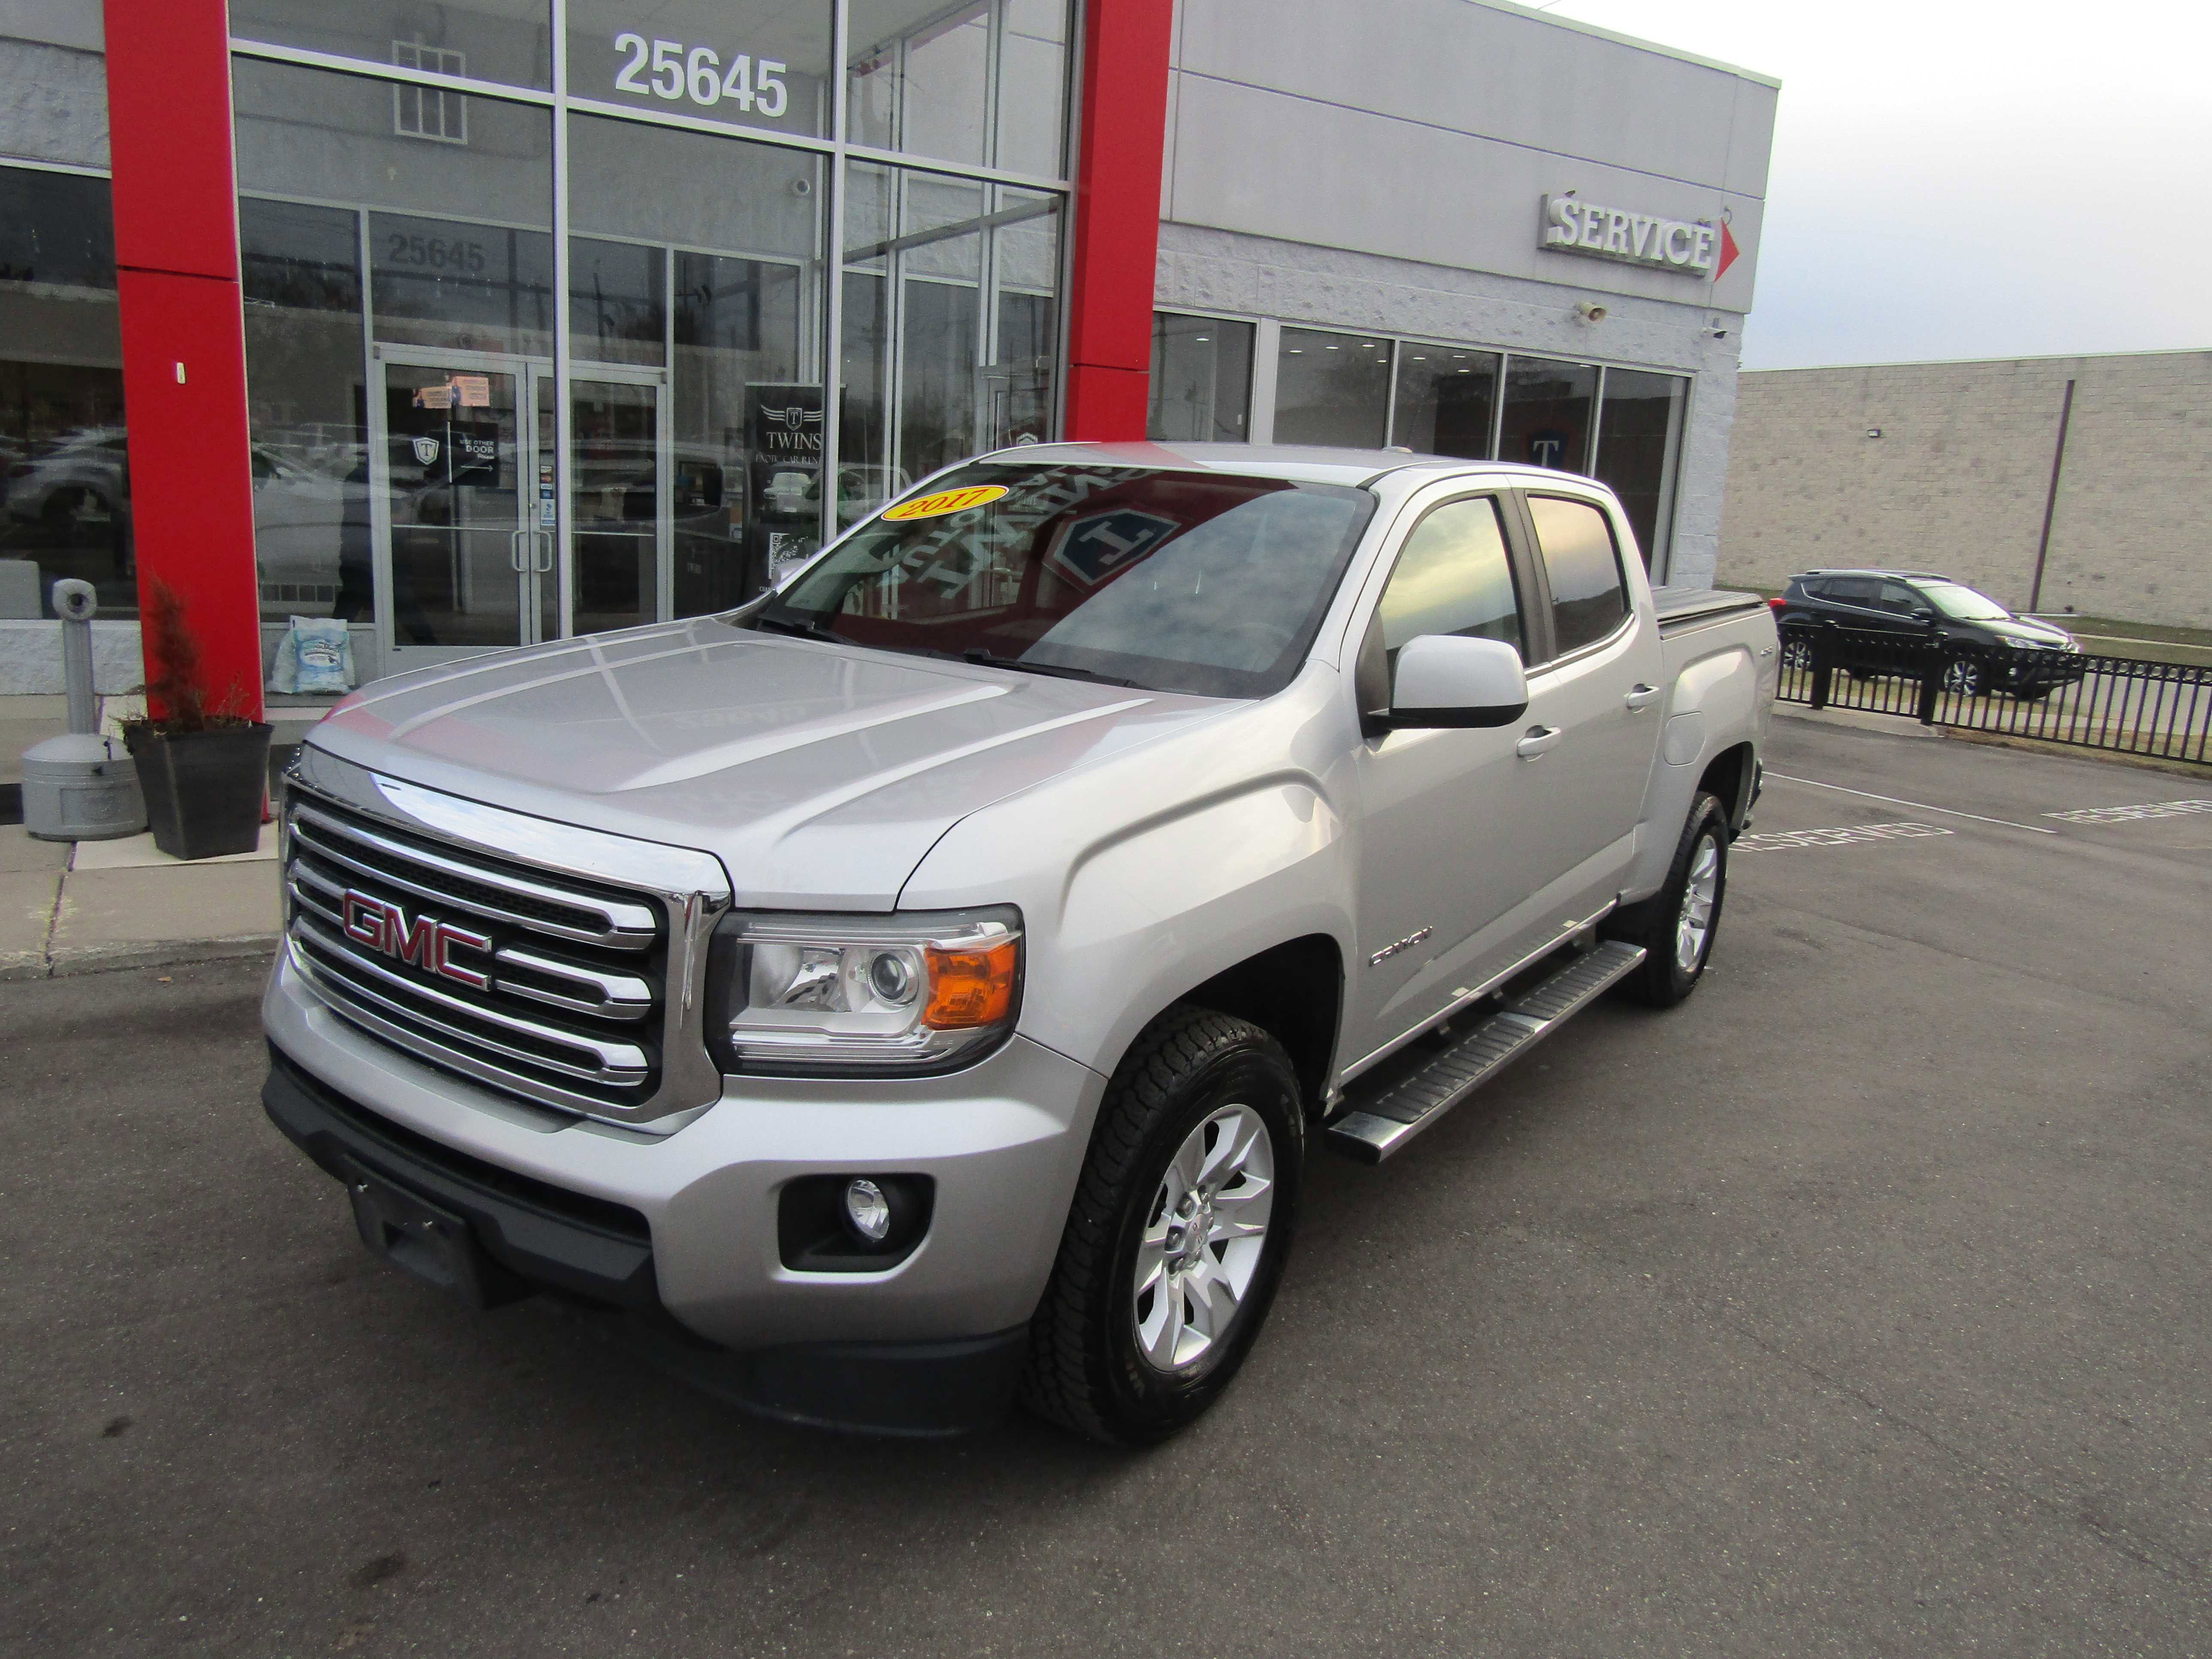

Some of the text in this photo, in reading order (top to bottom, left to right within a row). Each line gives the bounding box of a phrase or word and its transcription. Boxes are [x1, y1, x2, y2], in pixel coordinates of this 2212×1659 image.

[614, 33, 788, 118] 25645
[1547, 198, 1715, 269] SERVICE
[388, 234, 484, 272] 25645
[790, 411, 799, 425] T
[421, 443, 432, 456] T
[466, 445, 494, 453] DOOR
[766, 432, 821, 451] TWINS
[1533, 441, 1559, 467] T
[783, 455, 799, 464] CAR
[896, 488, 990, 518] 2017
[345, 888, 492, 992] GMC
